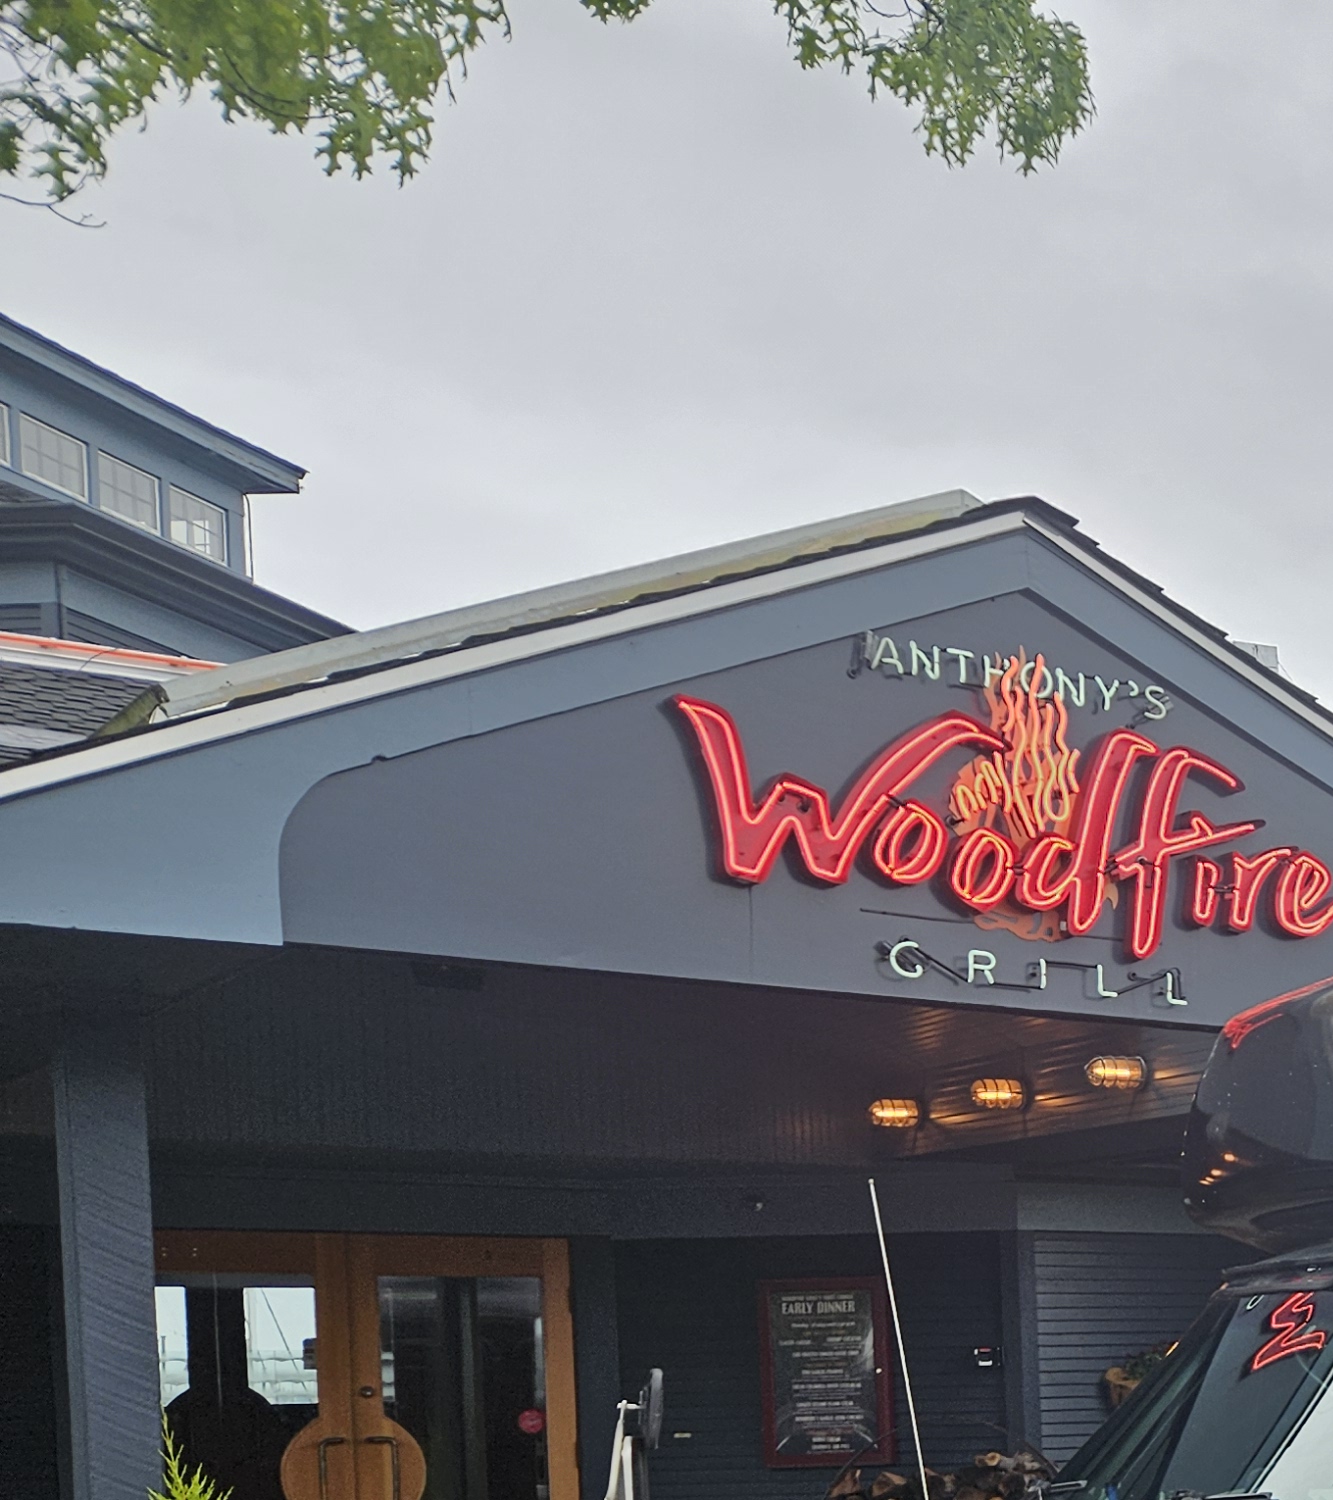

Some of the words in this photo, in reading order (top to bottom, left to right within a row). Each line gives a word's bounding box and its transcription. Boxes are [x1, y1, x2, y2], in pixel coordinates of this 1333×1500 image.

[870, 634, 1170, 720] ANTHONY'S
[888, 940, 1189, 1006] GRILL
[781, 1301, 814, 1315] EARLY
[817, 1300, 855, 1314] DINNER
